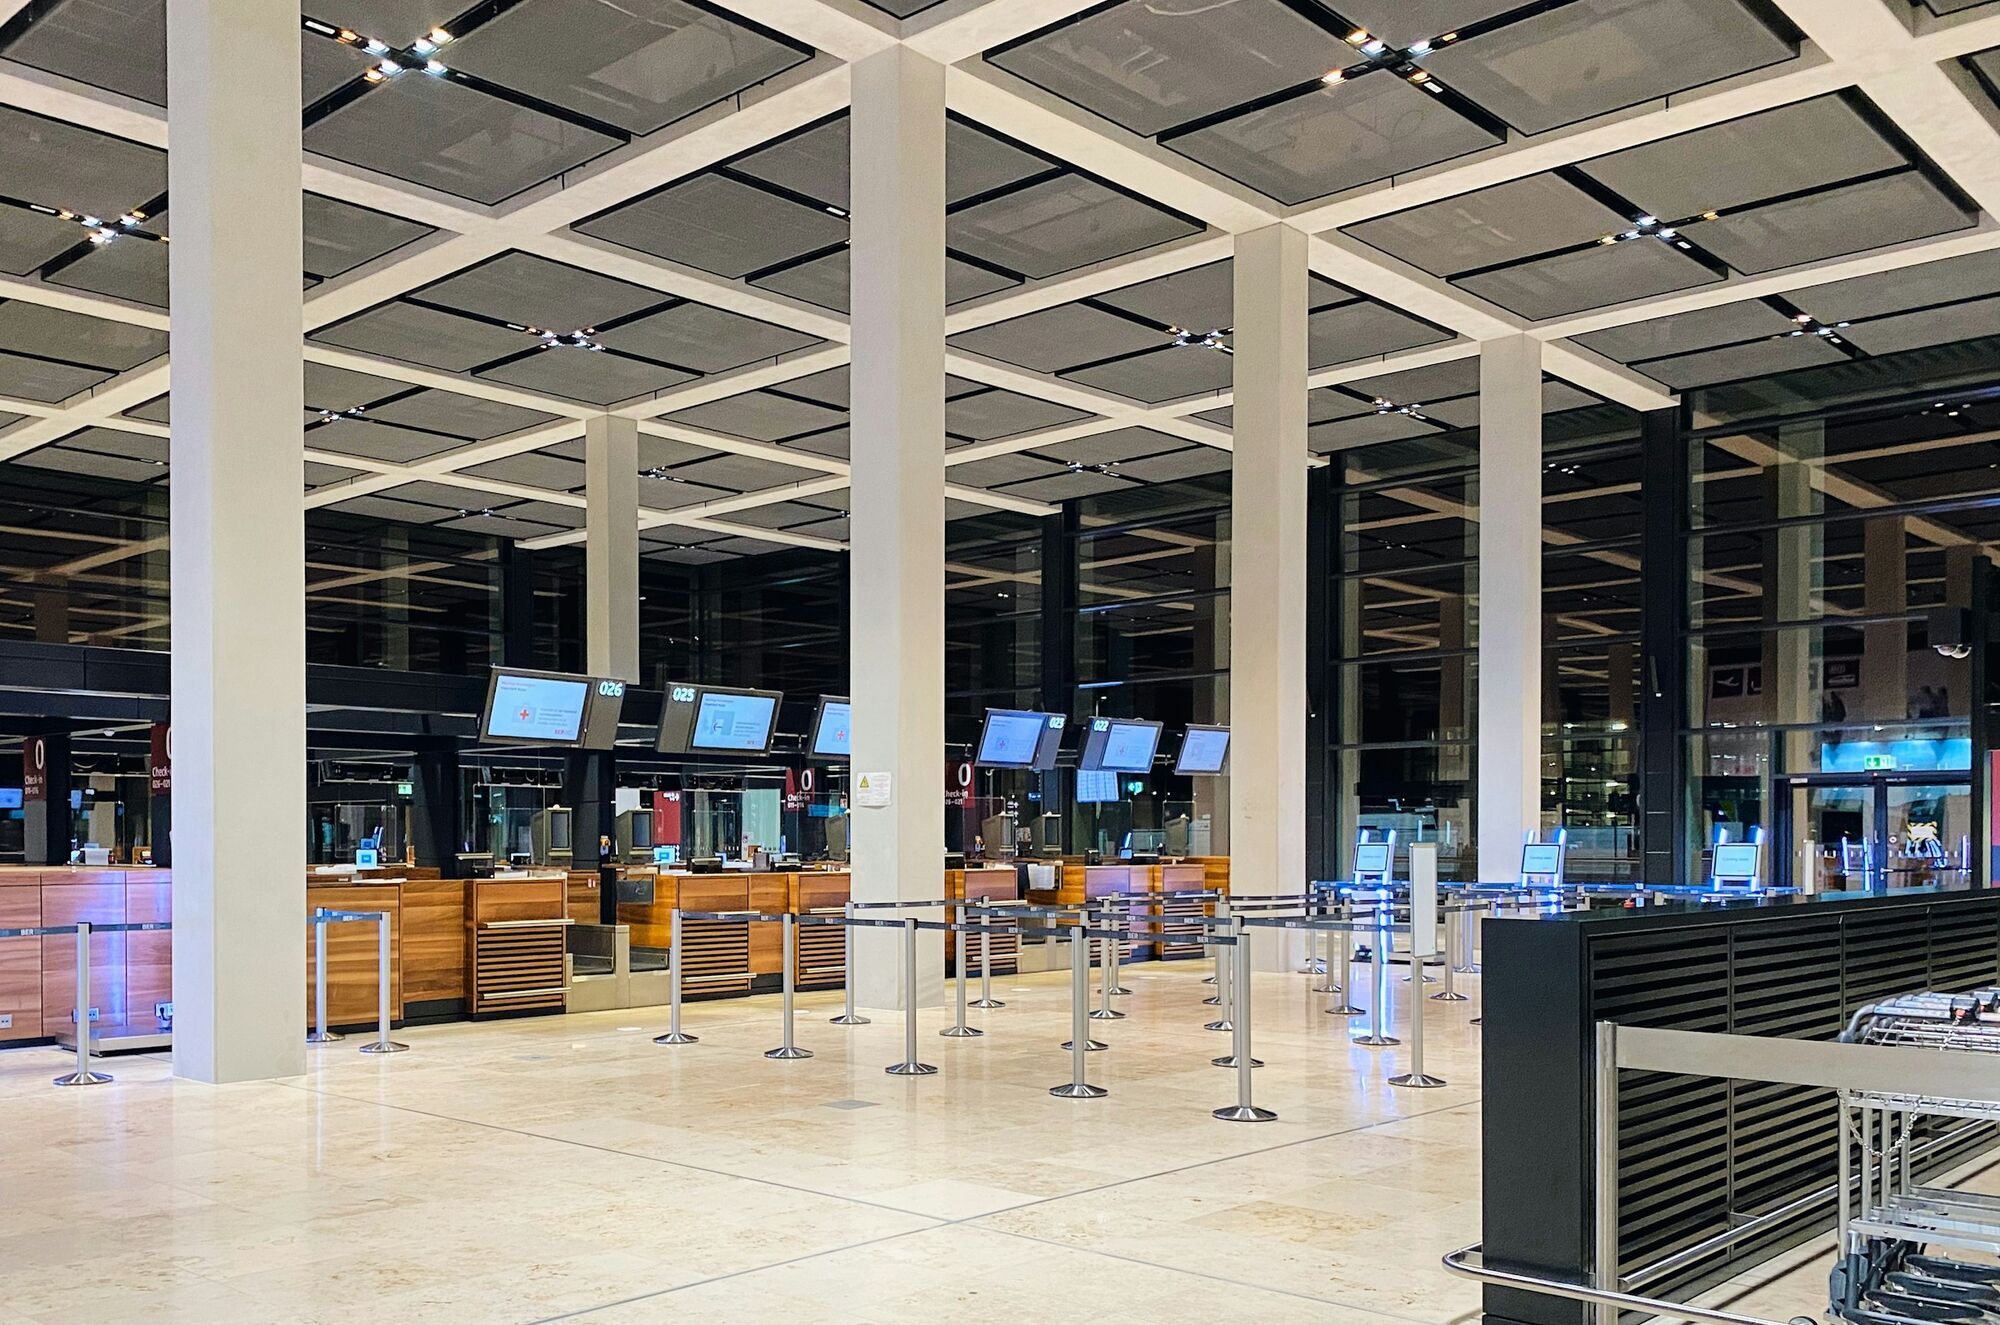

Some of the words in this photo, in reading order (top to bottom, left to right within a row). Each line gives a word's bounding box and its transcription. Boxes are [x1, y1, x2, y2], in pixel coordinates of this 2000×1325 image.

[599, 681, 623, 697] 026
[672, 687, 695, 702] 025
[1050, 717, 1065, 729] 023
[1094, 720, 1108, 732] 022
[35, 739, 45, 770] 0
[801, 769, 812, 791] 0
[958, 763, 971, 787] 0
